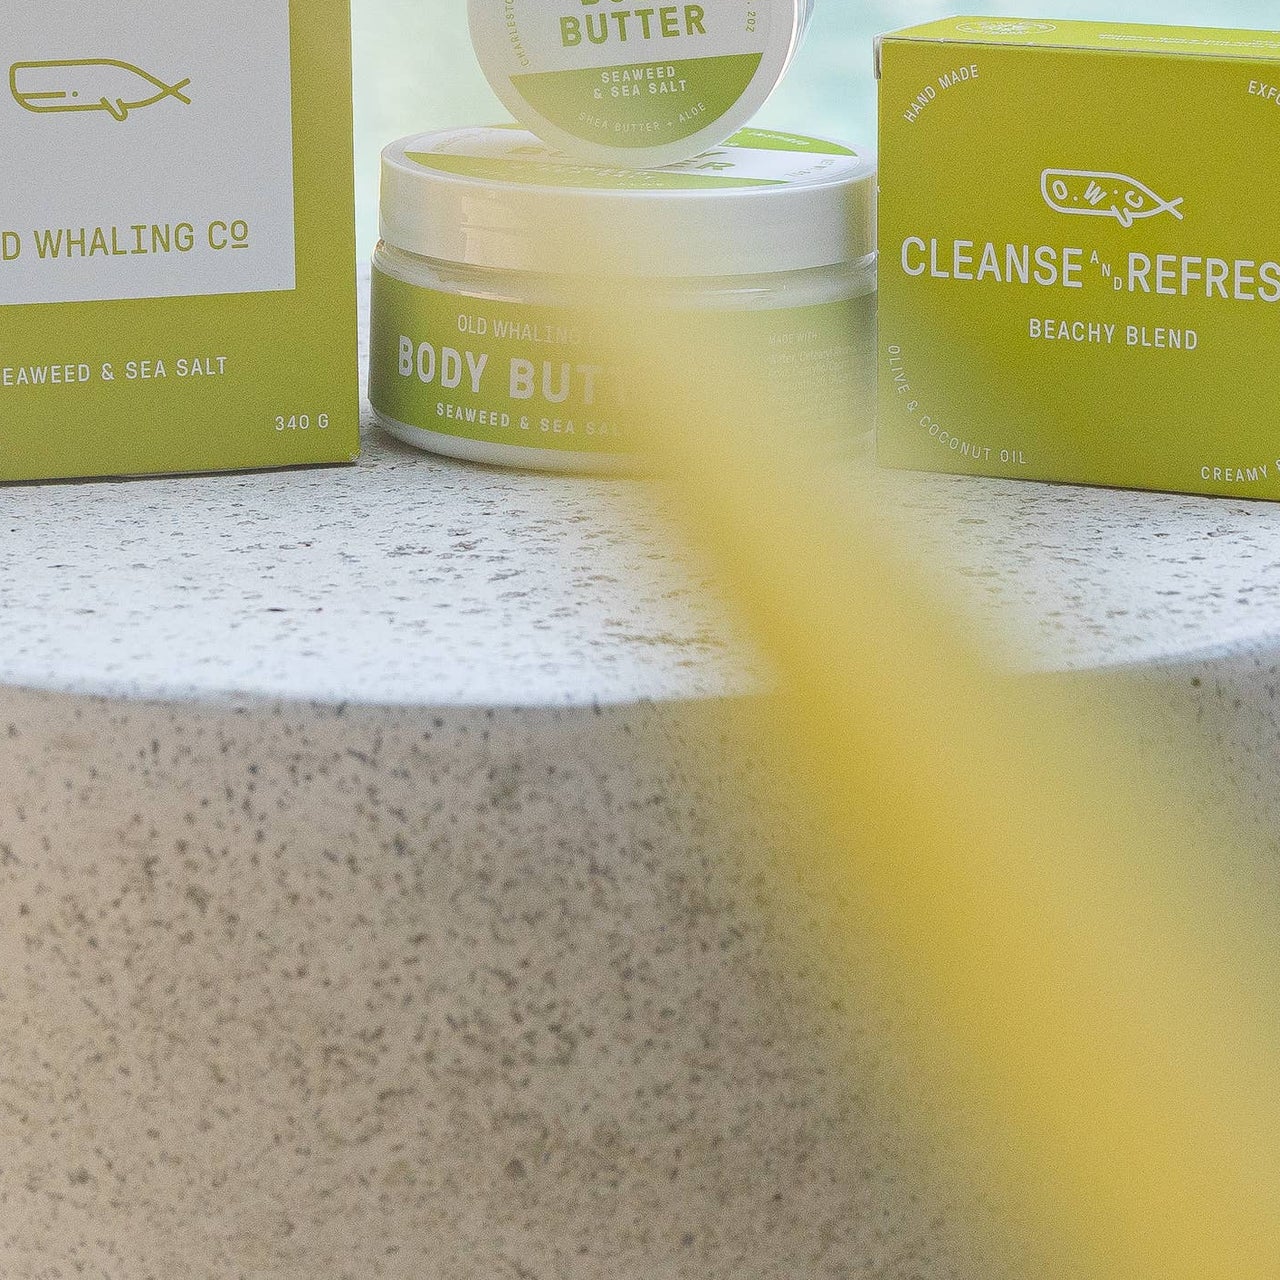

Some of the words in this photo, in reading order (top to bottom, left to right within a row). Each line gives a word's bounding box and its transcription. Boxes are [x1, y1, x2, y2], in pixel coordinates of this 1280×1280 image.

[559, 4, 707, 48] BUTTER
[593, 87, 603, 100] &
[610, 84, 641, 98] SEA
[648, 80, 687, 95] SALT
[601, 66, 676, 84] SEAWEED
[903, 86, 936, 123] HAND
[938, 64, 979, 90] MADE
[615, 121, 662, 133] BUTTER
[678, 101, 707, 124] ALOE
[33, 221, 194, 259] WHALING
[900, 235, 1084, 289] CLEANSE
[1090, 250, 1123, 291] AND
[457, 314, 487, 336] OLD
[1029, 318, 1115, 346] BEACHY
[1125, 325, 1199, 351] BLEND
[101, 362, 115, 380] &
[125, 359, 167, 380] SEA
[176, 356, 228, 377] SALT
[398, 334, 489, 393] BODY
[436, 402, 511, 428] SEAWEED
[519, 416, 530, 430] &
[539, 418, 576, 434] SEA
[888, 345, 911, 394] OLIVE
[906, 400, 919, 413] &
[919, 415, 992, 461] COCONUT
[999, 449, 1027, 465] OIL
[275, 414, 310, 431] 340
[318, 413, 329, 429] G
[1201, 464, 1269, 482] CREAMY
